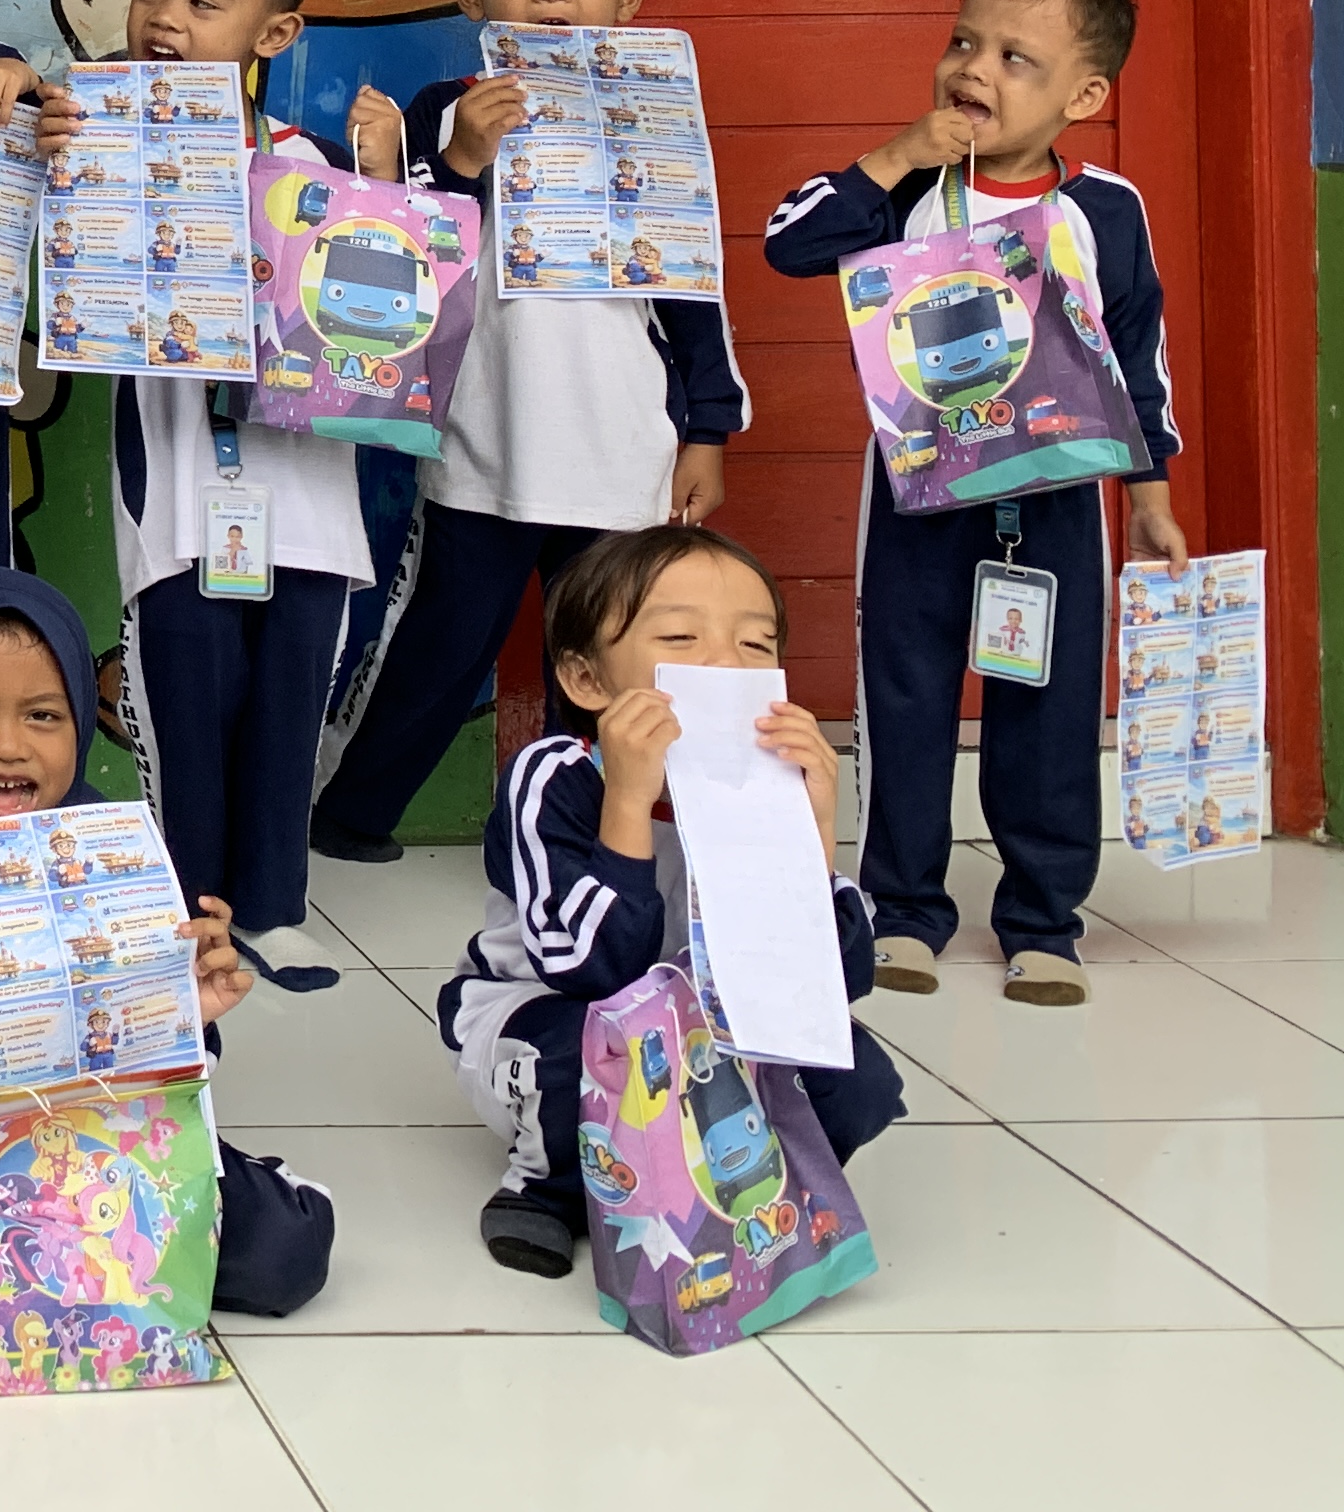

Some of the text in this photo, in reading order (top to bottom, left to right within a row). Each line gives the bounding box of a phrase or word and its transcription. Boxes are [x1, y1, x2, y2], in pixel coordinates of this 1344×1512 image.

[349, 237, 369, 247] 120
[928, 299, 948, 308] 120
[322, 347, 401, 388] TAYO
[940, 400, 1014, 433] TAYO
[734, 1201, 799, 1258] TAYO
